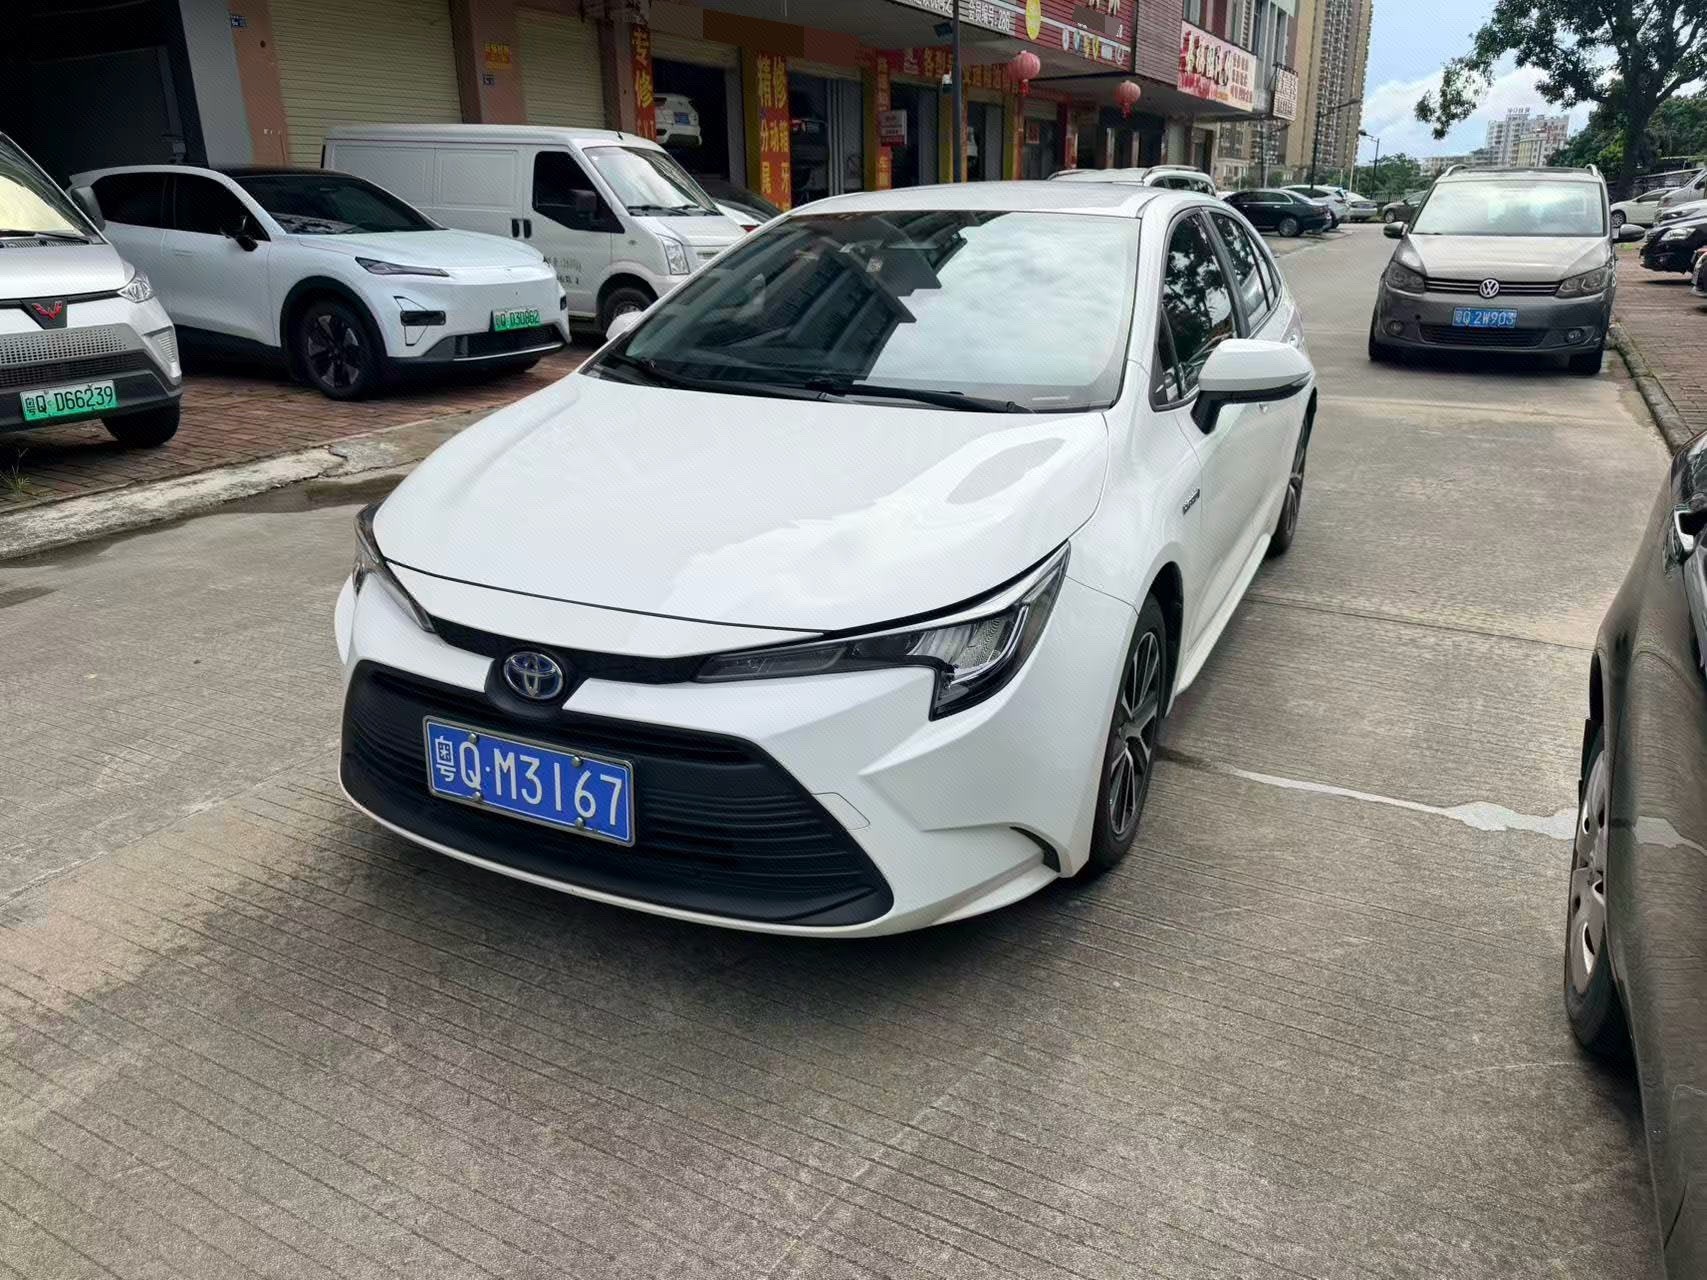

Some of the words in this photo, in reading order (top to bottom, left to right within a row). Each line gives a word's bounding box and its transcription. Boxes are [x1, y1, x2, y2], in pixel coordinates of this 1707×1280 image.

[758, 55, 788, 108] 精修
[760, 119, 790, 153] 分动箱
[434, 735, 623, 826] 粤Q·M3167
